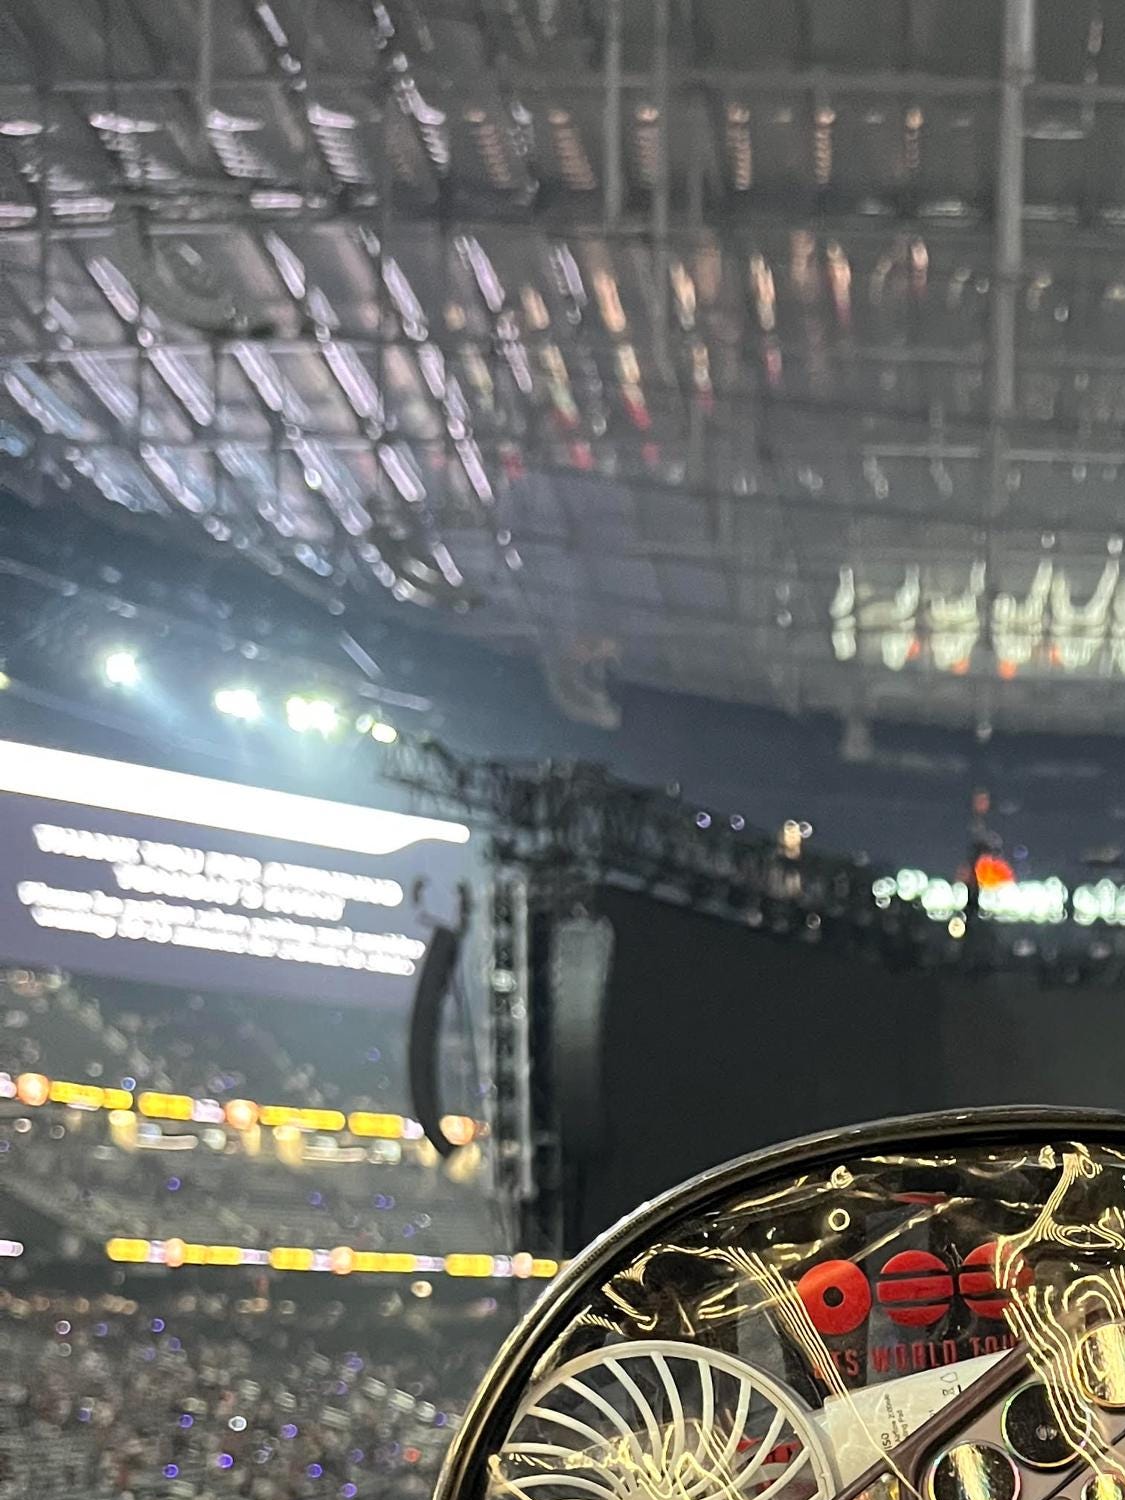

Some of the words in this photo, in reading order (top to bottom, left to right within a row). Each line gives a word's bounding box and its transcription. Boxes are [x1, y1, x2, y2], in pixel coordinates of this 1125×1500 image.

[814, 1349, 859, 1378] TS
[871, 1339, 958, 1372] WORLD
[969, 1334, 1020, 1356] TOU
